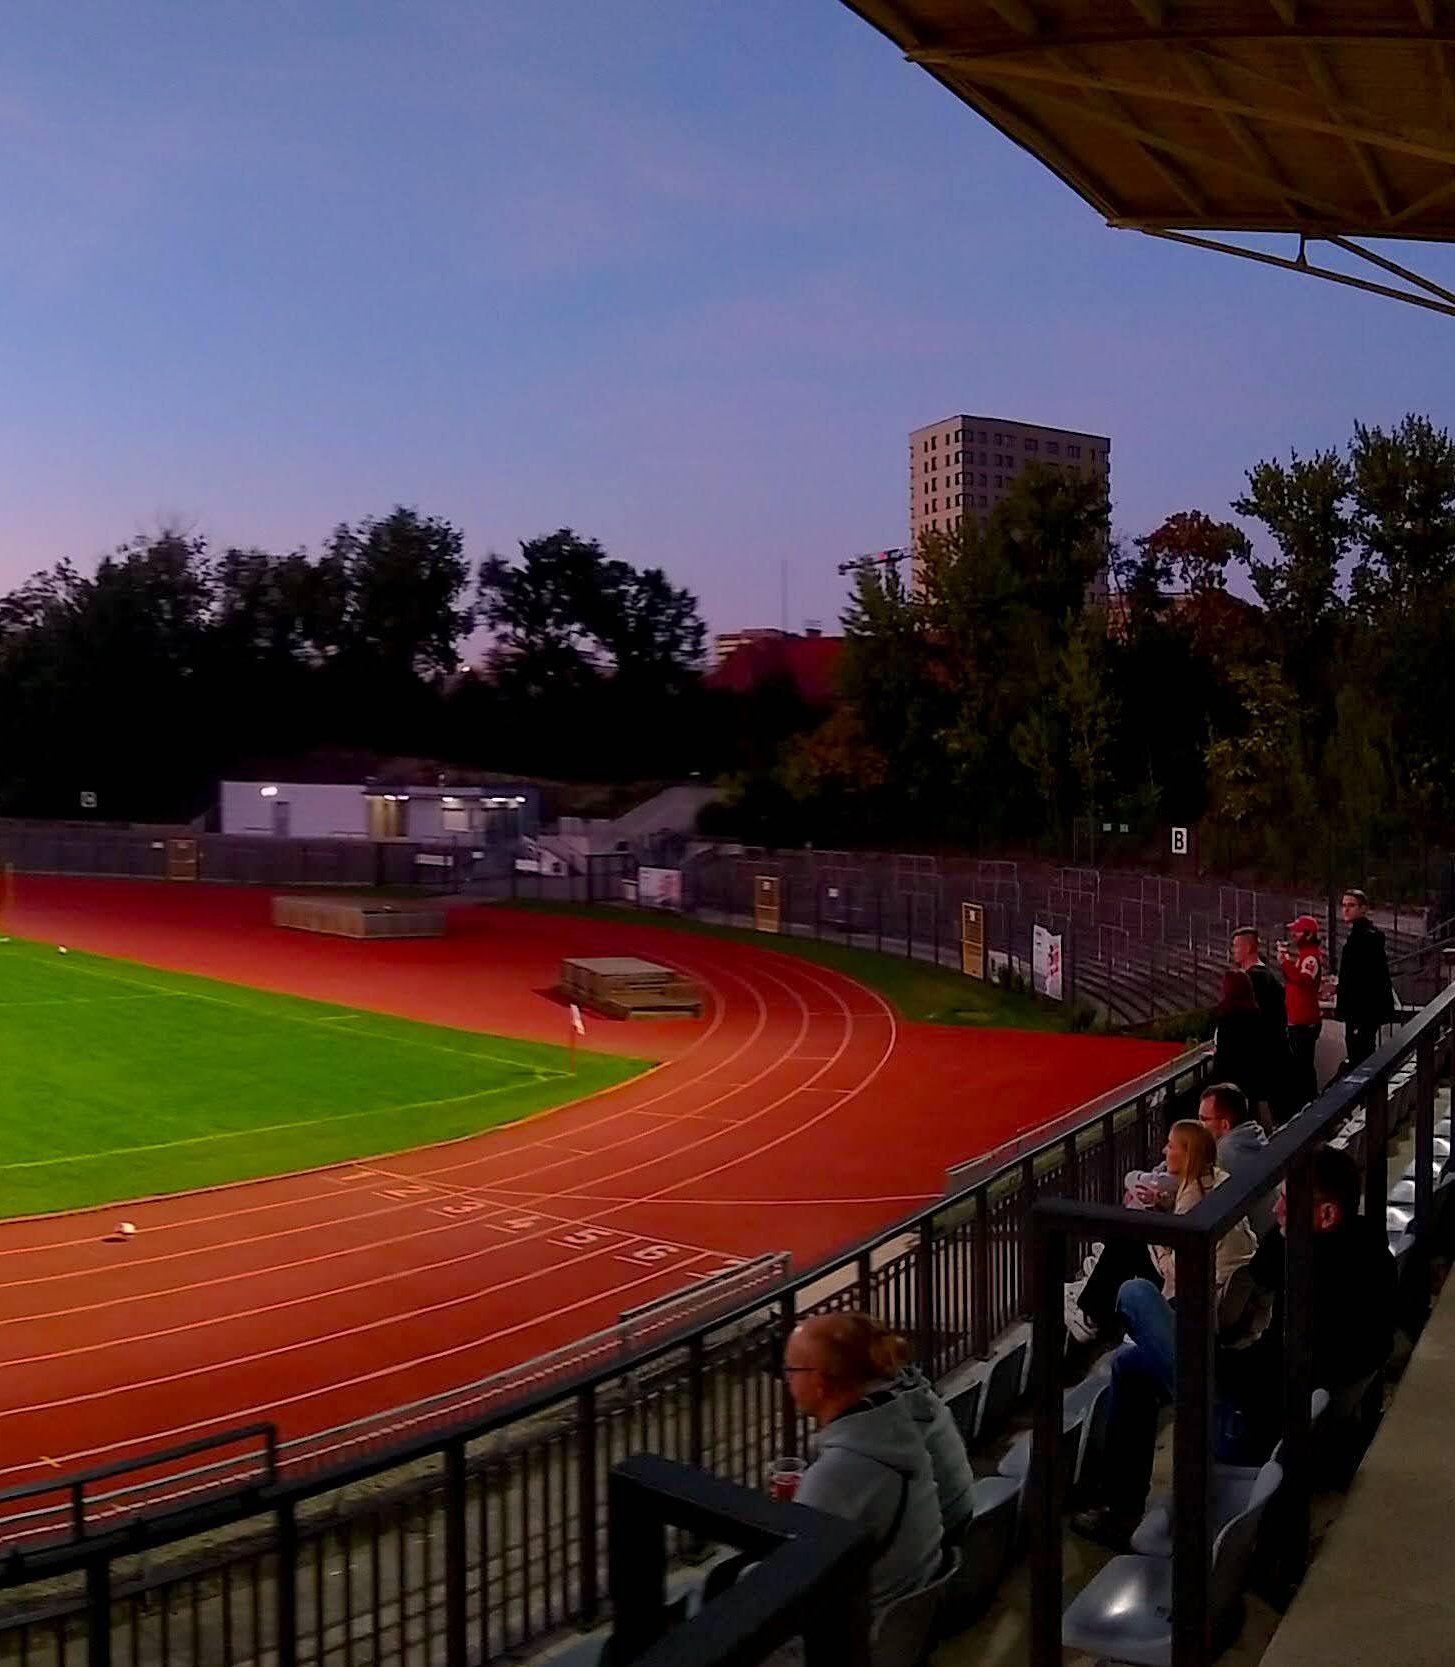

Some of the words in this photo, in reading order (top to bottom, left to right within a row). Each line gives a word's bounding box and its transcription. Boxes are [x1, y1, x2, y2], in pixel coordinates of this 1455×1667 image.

[1174, 830, 1184, 850] B
[383, 1184, 430, 1198] 2
[441, 1200, 486, 1214] 3
[563, 1228, 614, 1245] 5
[632, 1244, 681, 1261] 6
